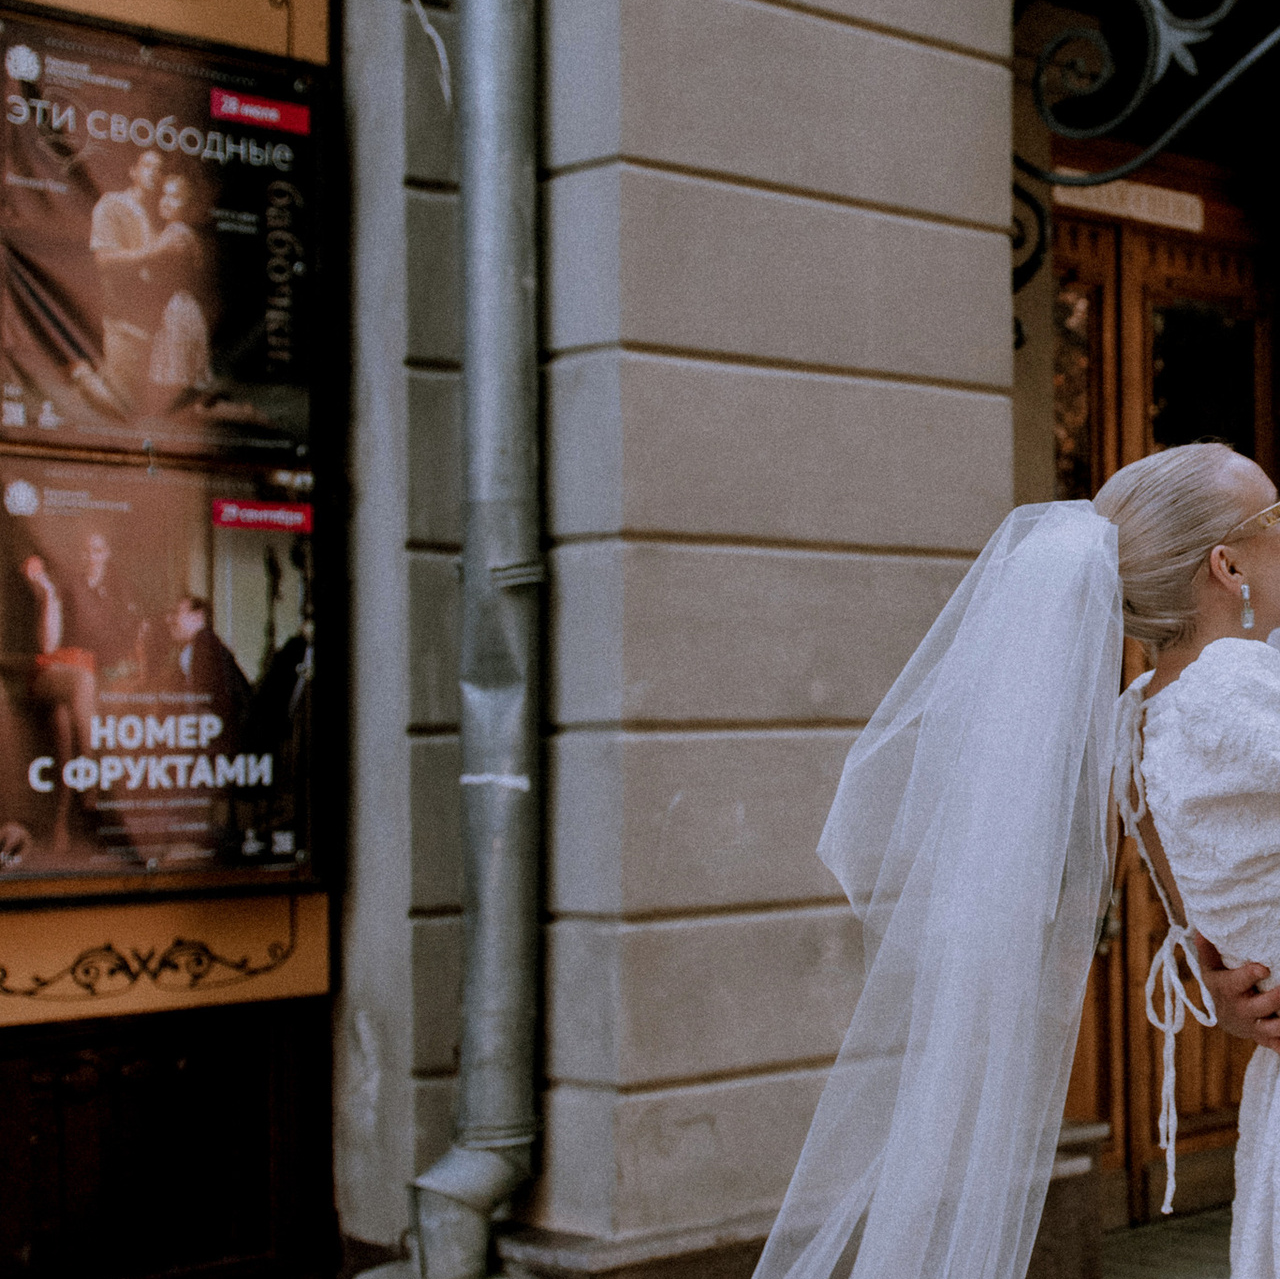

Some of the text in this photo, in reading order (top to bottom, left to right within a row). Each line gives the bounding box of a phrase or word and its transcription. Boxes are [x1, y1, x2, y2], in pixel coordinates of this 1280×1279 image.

[90, 714, 224, 750] НОМЕР
[27, 752, 274, 792] С ФРУКТАМИ
